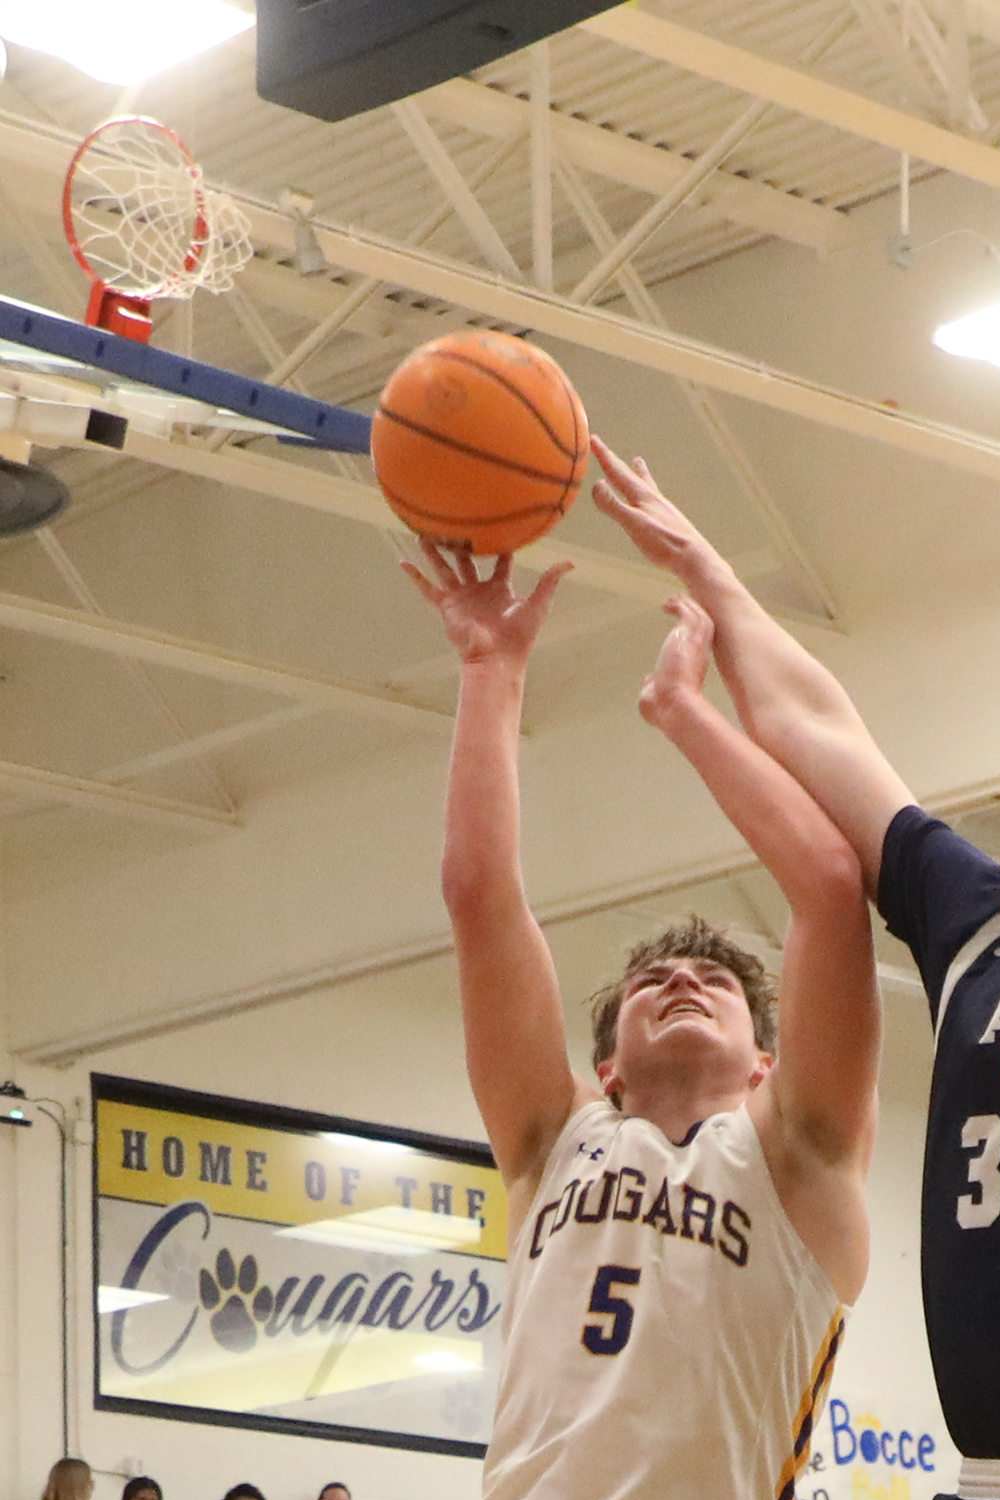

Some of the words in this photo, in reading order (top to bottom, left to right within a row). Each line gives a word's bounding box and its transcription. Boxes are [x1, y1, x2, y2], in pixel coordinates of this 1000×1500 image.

[121, 1128, 268, 1193] HOME
[304, 1160, 361, 1206] OF
[396, 1176, 487, 1229] THE
[529, 1166, 752, 1268] COUGARS
[581, 1264, 642, 1356] 5
[829, 1399, 936, 1472] Bocce
